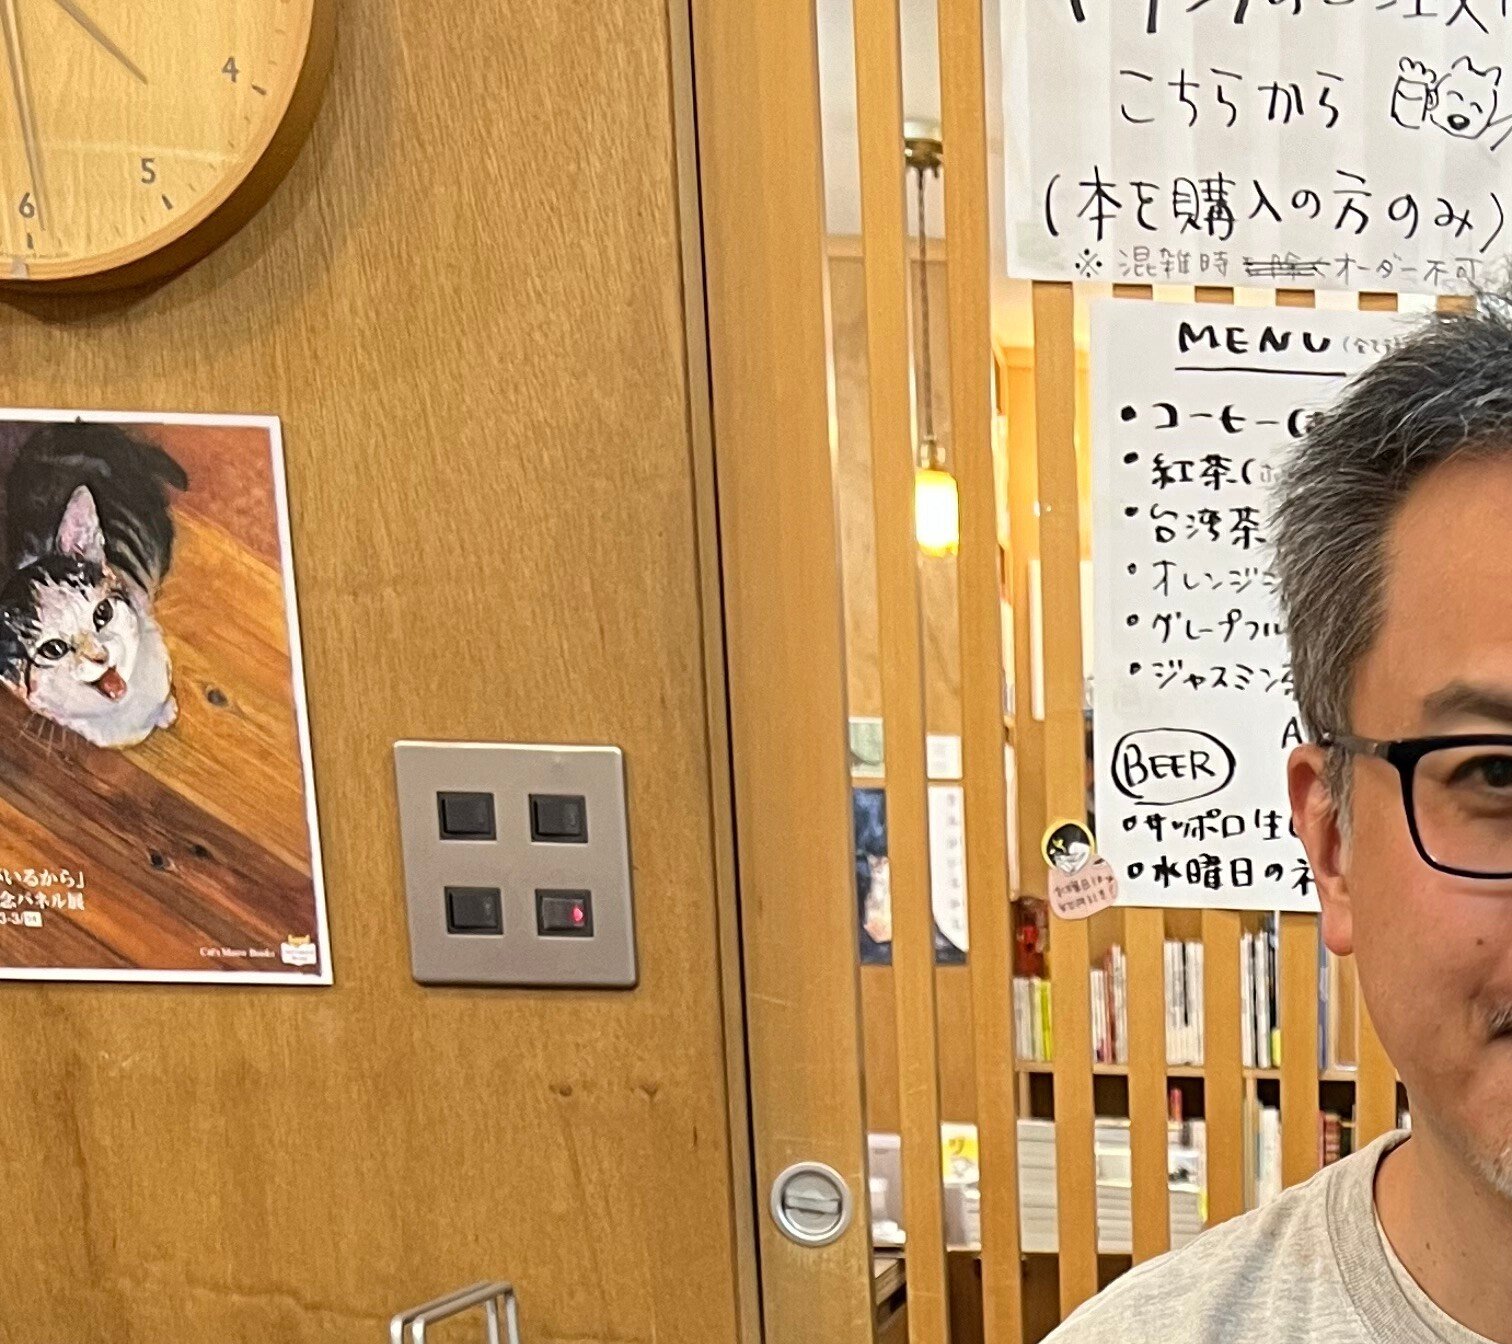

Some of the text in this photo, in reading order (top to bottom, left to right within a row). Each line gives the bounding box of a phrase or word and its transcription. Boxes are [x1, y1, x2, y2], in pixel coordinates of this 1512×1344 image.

[221, 56, 240, 83] 4
[1119, 68, 1345, 129] こちらから
[140, 157, 157, 184] 5
[18, 191, 36, 219] 6
[1177, 321, 1331, 355] MENU
[1150, 502, 1268, 550] 台湾茶
[1123, 743, 1216, 788] BEER
